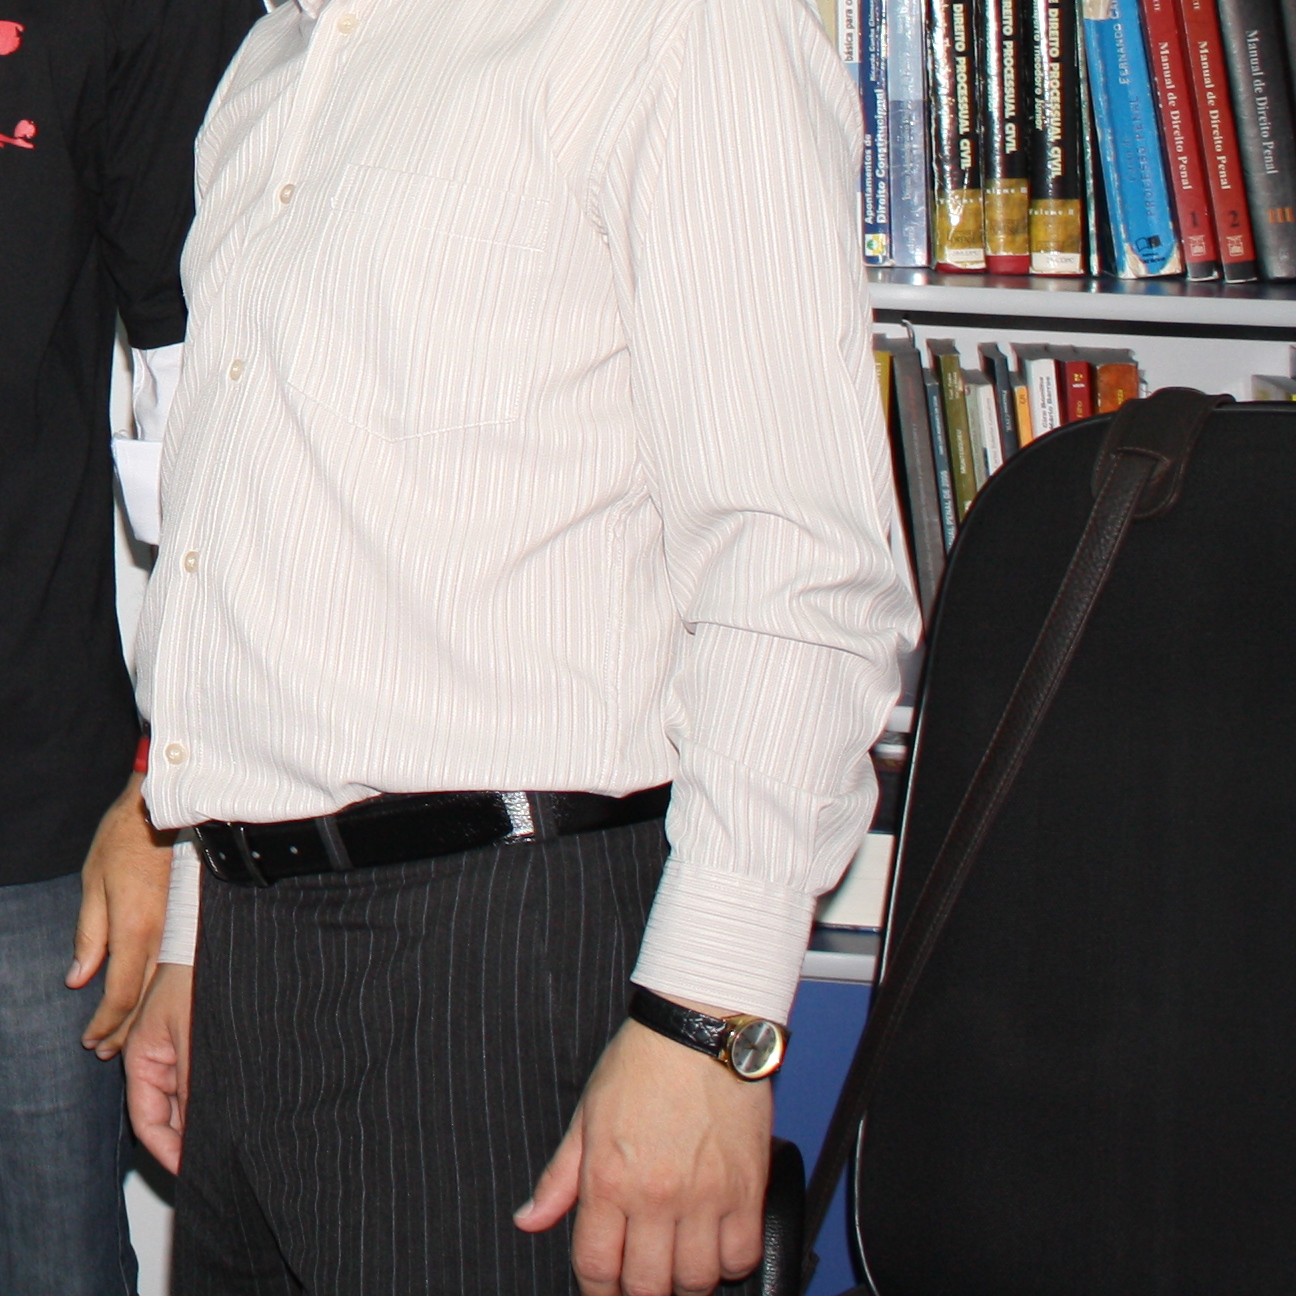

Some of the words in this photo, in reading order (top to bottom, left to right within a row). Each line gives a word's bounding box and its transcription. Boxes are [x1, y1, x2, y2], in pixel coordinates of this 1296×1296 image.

[845, 8, 855, 30] para
[953, 4, 966, 53] DIREITO
[1048, 8, 1061, 58] DIREITO
[1113, 23, 1131, 85] FERNANDO
[1158, 41, 1176, 90] Manual
[1197, 41, 1215, 90] Manual
[1245, 29, 1264, 78] Manual
[955, 56, 970, 135] PROCESSUAL
[1002, 40, 1016, 120] PROCESSUAL
[1166, 91, 1180, 108] de
[1205, 90, 1219, 107] de
[1252, 78, 1268, 95] de
[1048, 62, 1062, 143] PROCESSUAL
[1255, 95, 1272, 139] Direito
[863, 133, 873, 147] de
[1005, 123, 1017, 154] CIVIL
[1169, 109, 1185, 153] Direito
[1208, 109, 1224, 153] Direito
[960, 138, 972, 171] CIVIL
[1050, 146, 1062, 179] CIVIL
[1177, 155, 1194, 191] Penal
[1216, 155, 1233, 191] Penal
[1262, 140, 1279, 175] Penal
[864, 149, 875, 224] Apontamentos
[876, 182, 887, 224] Direito
